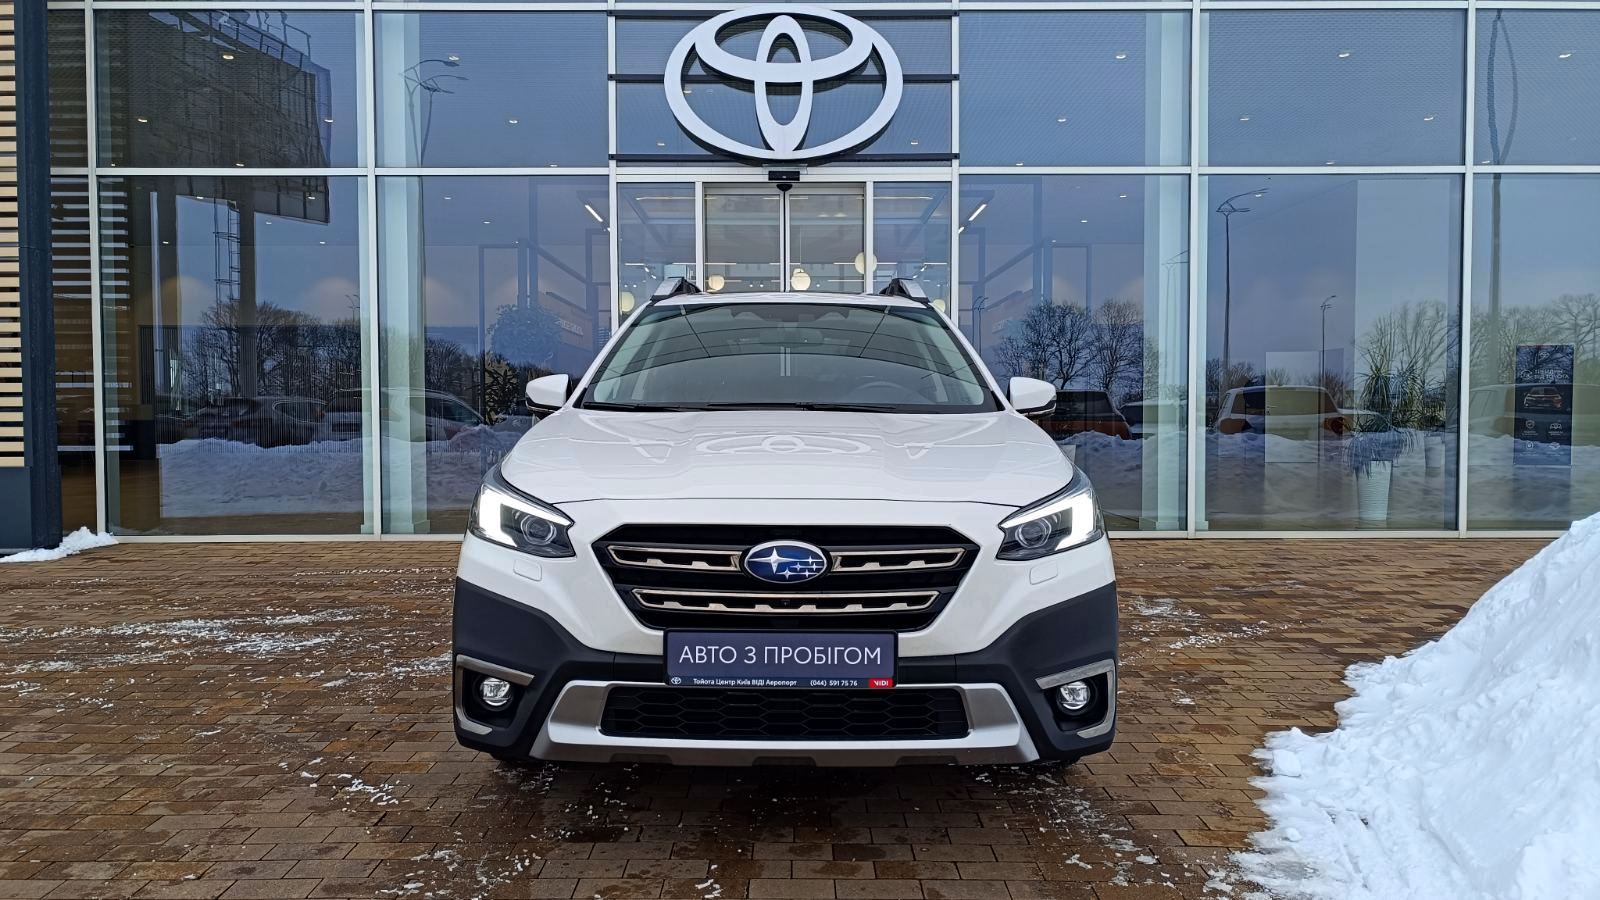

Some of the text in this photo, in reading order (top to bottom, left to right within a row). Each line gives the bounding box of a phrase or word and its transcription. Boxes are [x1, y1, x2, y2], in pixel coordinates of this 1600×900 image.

[679, 646, 737, 664] АВТО
[764, 646, 881, 665] ПРОБІГОМ
[715, 678, 736, 686] Центр
[765, 679, 798, 687] Аеропорт
[810, 679, 827, 687] (044)
